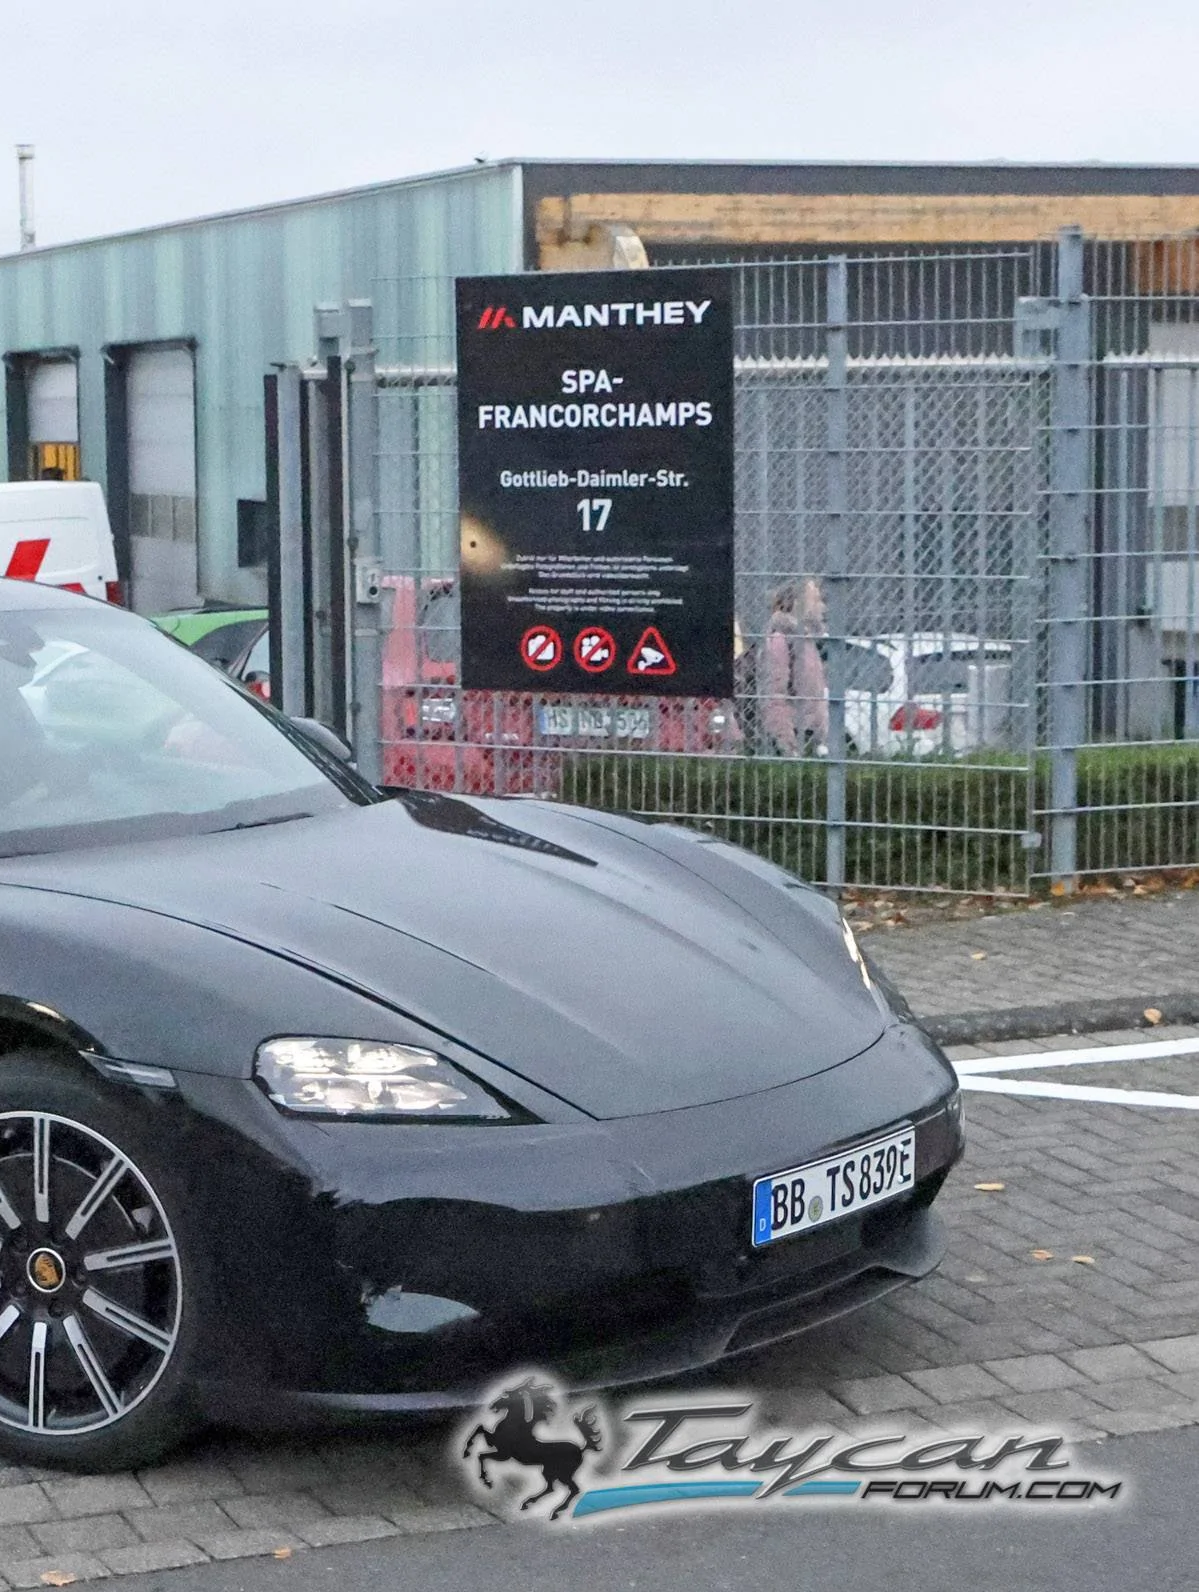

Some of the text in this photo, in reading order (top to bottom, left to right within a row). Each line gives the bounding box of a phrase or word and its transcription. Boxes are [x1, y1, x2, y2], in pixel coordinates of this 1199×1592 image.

[522, 300, 712, 329] MANTHEY
[561, 369, 624, 394] SPA-
[478, 402, 713, 429] FRANCORCHAMPS
[500, 469, 689, 488] Gottlieb-Daimler-Str.
[576, 498, 613, 532] 17
[771, 1178, 806, 1231] BB
